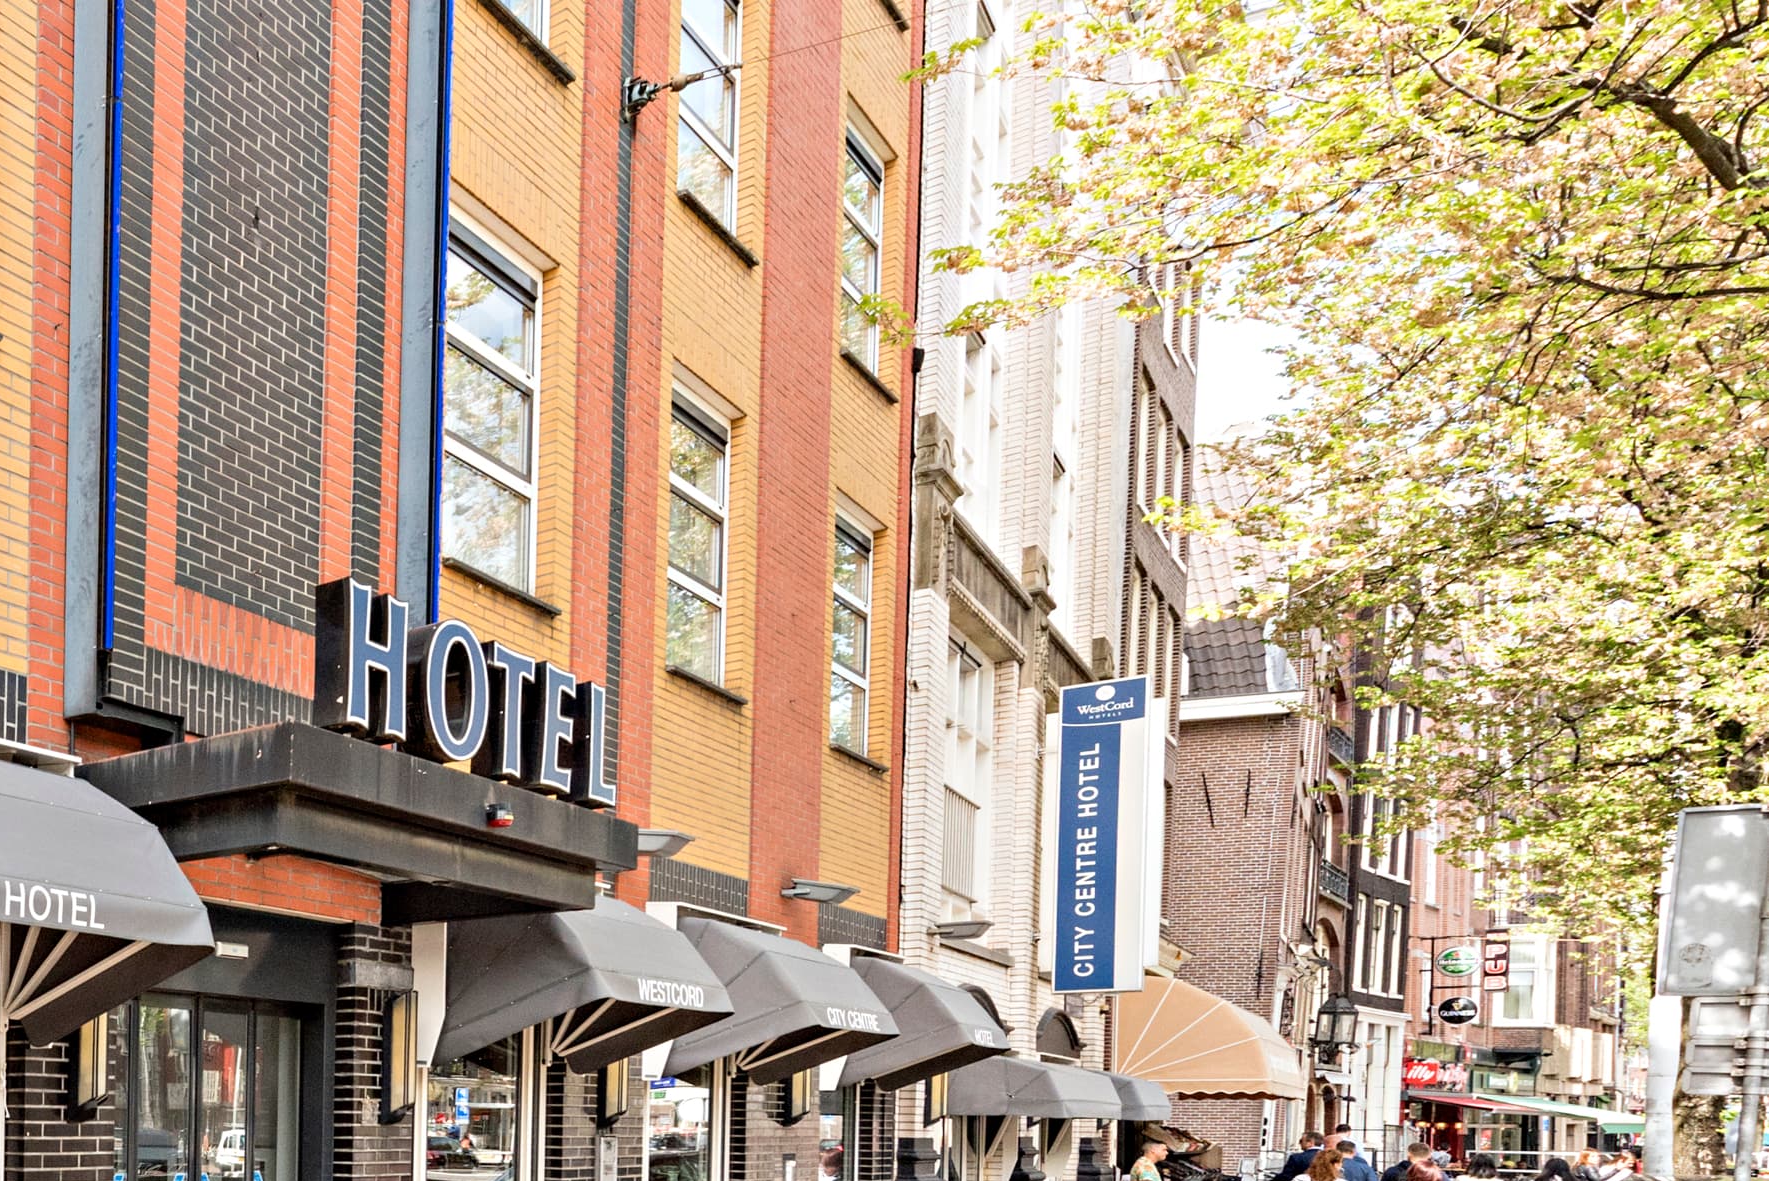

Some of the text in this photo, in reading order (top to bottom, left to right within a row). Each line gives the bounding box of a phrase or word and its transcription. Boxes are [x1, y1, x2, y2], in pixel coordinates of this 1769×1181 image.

[346, 577, 617, 807] HOTEL
[1077, 697, 1134, 715] WestCord
[1073, 742, 1100, 977] CITY CENTRE HOTEL
[4, 880, 105, 930] HOTEL
[1483, 943, 1508, 990] PUB
[637, 977, 704, 1008] WESTCORD
[827, 1006, 881, 1032] CITY CENTRE
[974, 1028, 995, 1046] HOTEL
[1406, 1065, 1436, 1082] illy
